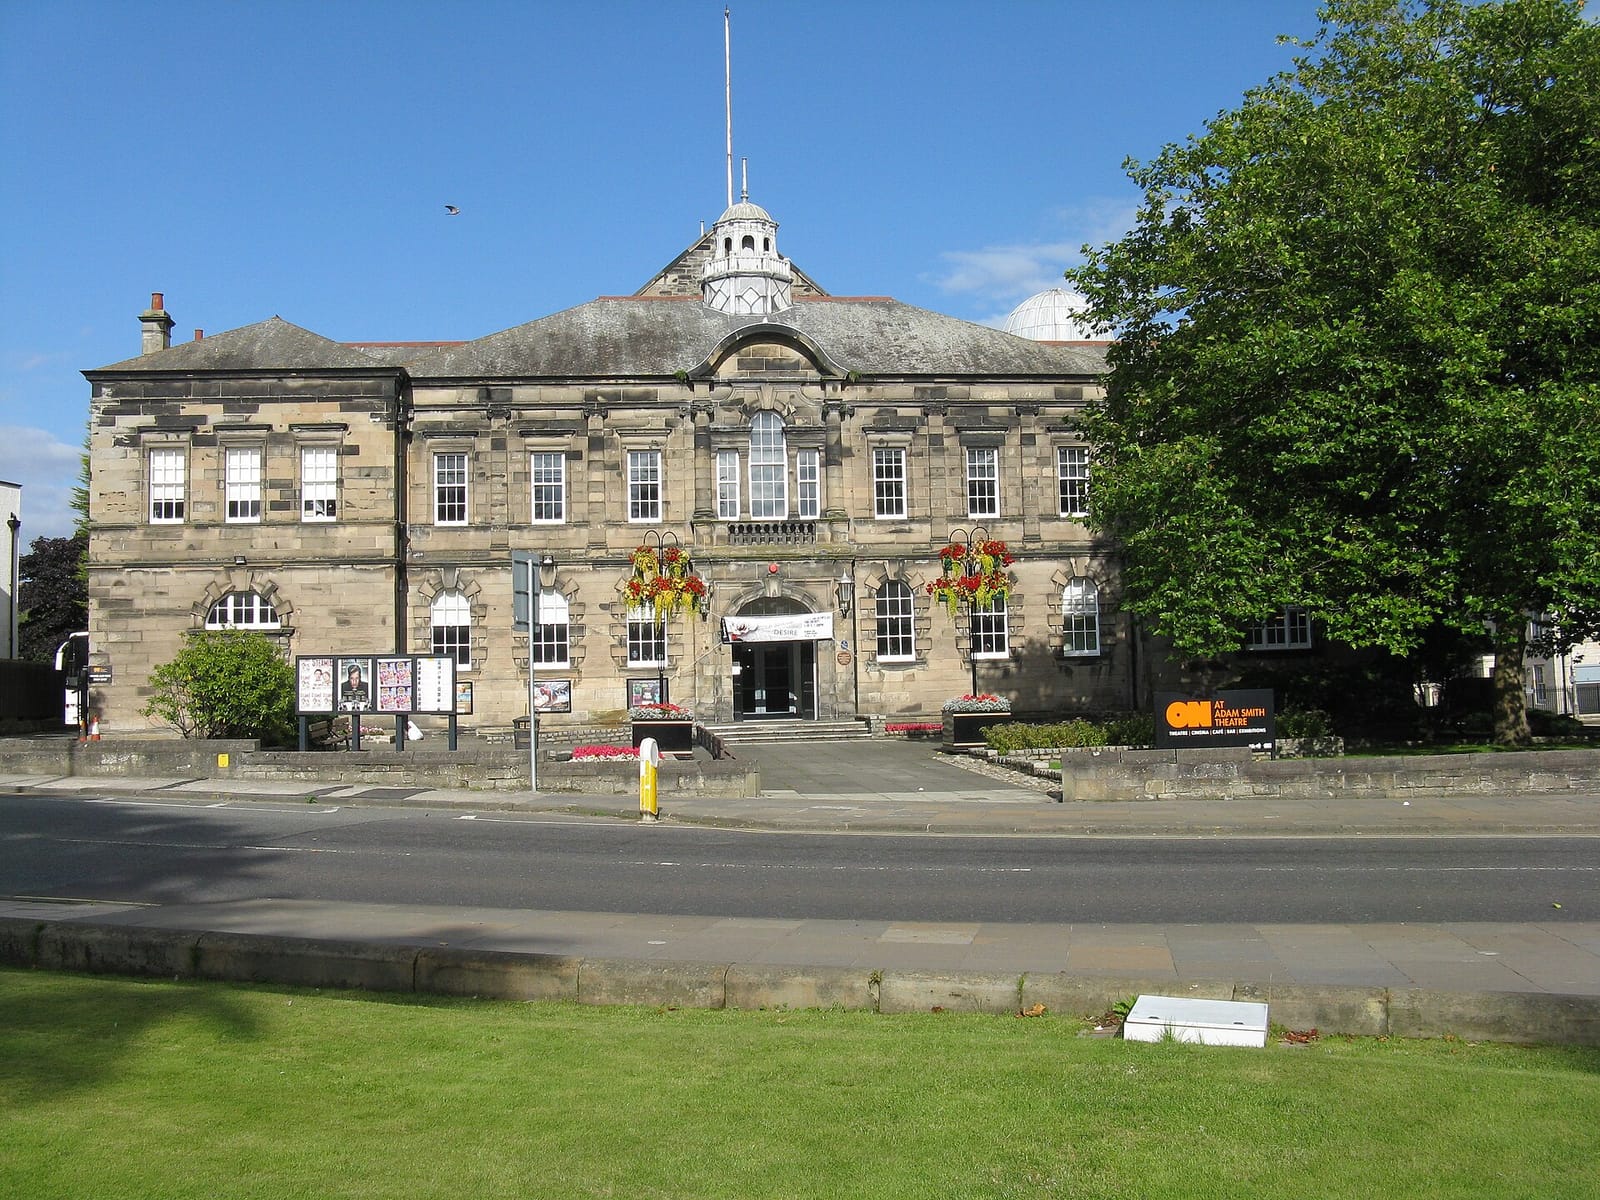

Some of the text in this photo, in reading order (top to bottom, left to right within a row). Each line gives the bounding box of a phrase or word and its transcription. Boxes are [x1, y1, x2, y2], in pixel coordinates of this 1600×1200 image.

[1214, 701, 1224, 710] AT
[1214, 708, 1265, 718] ADAM SMITH
[1214, 717, 1248, 727] THEATRE
